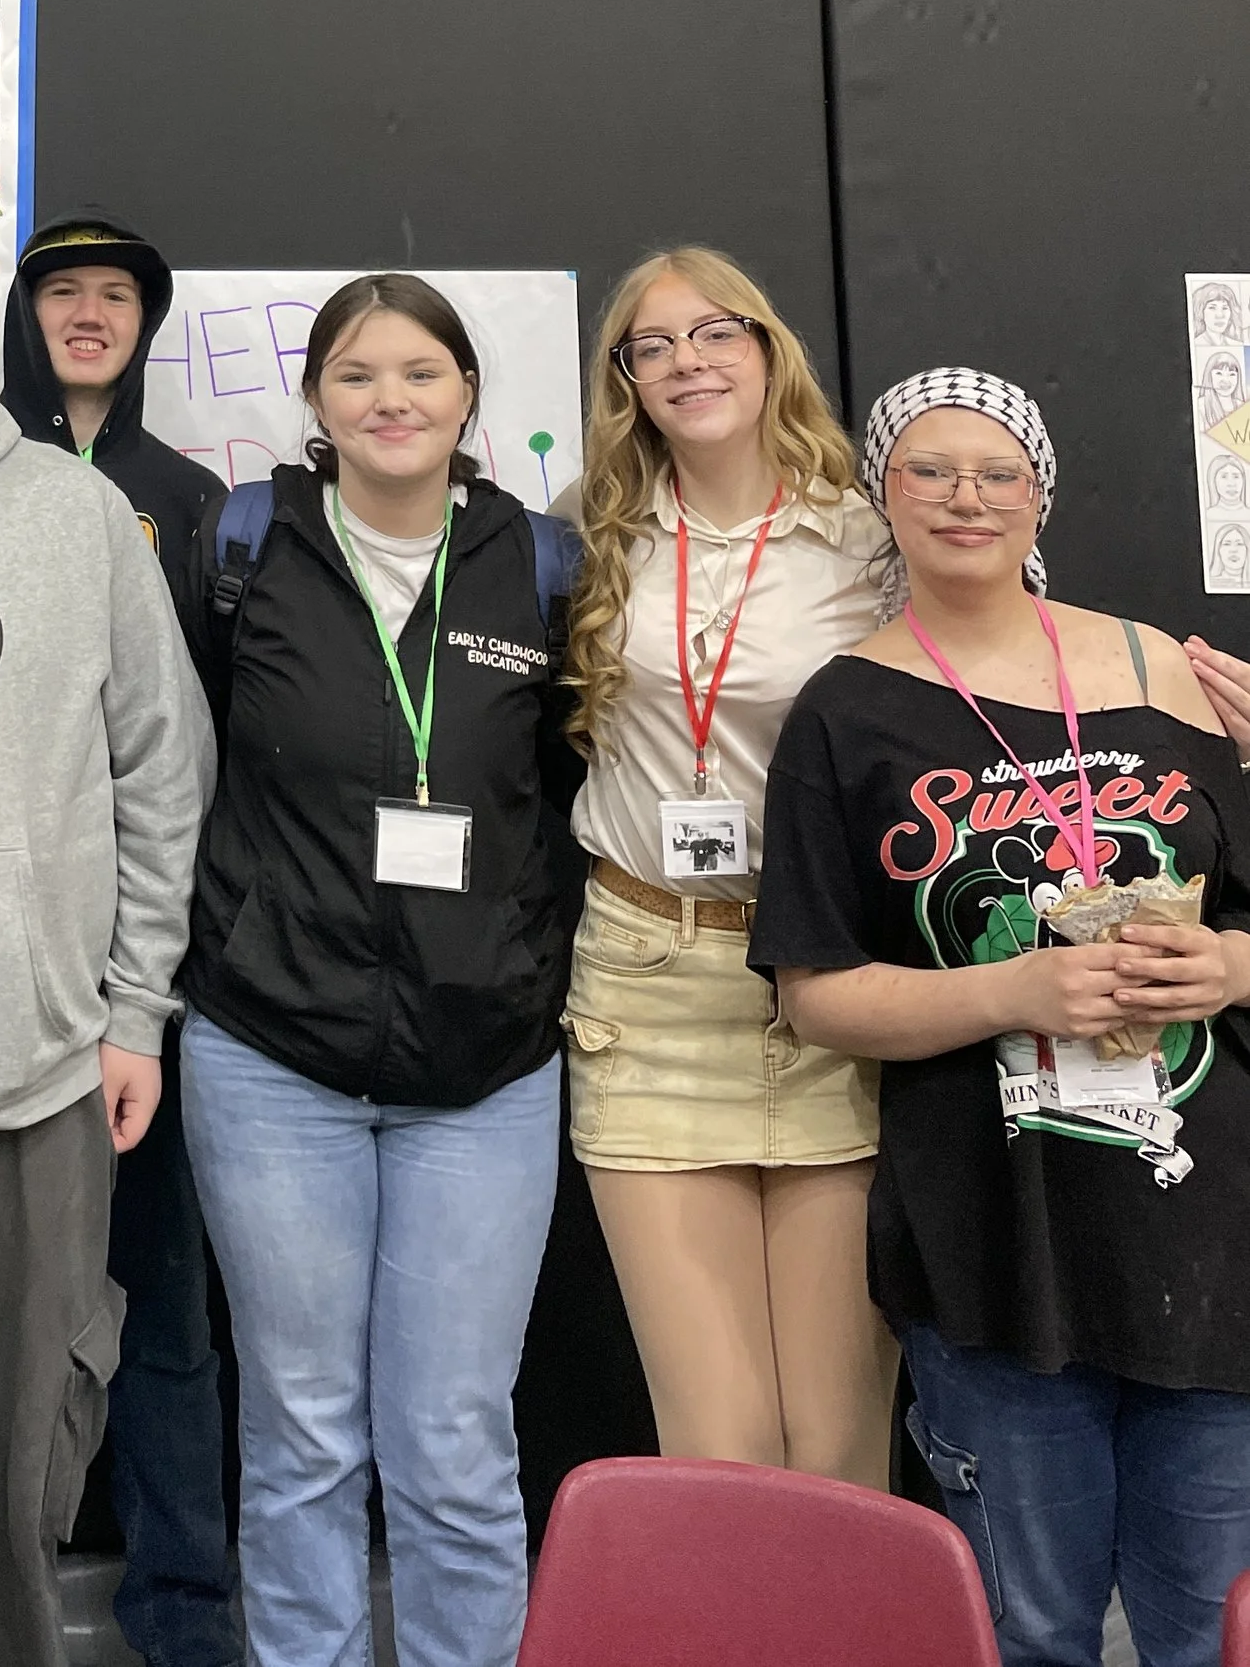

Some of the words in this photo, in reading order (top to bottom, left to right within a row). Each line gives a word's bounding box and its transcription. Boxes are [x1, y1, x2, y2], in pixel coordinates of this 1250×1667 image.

[448, 631, 485, 649] EARLY
[488, 637, 548, 666] CHILDHOOD
[467, 649, 530, 675] EDUCATION
[880, 768, 1192, 881] Sweet
